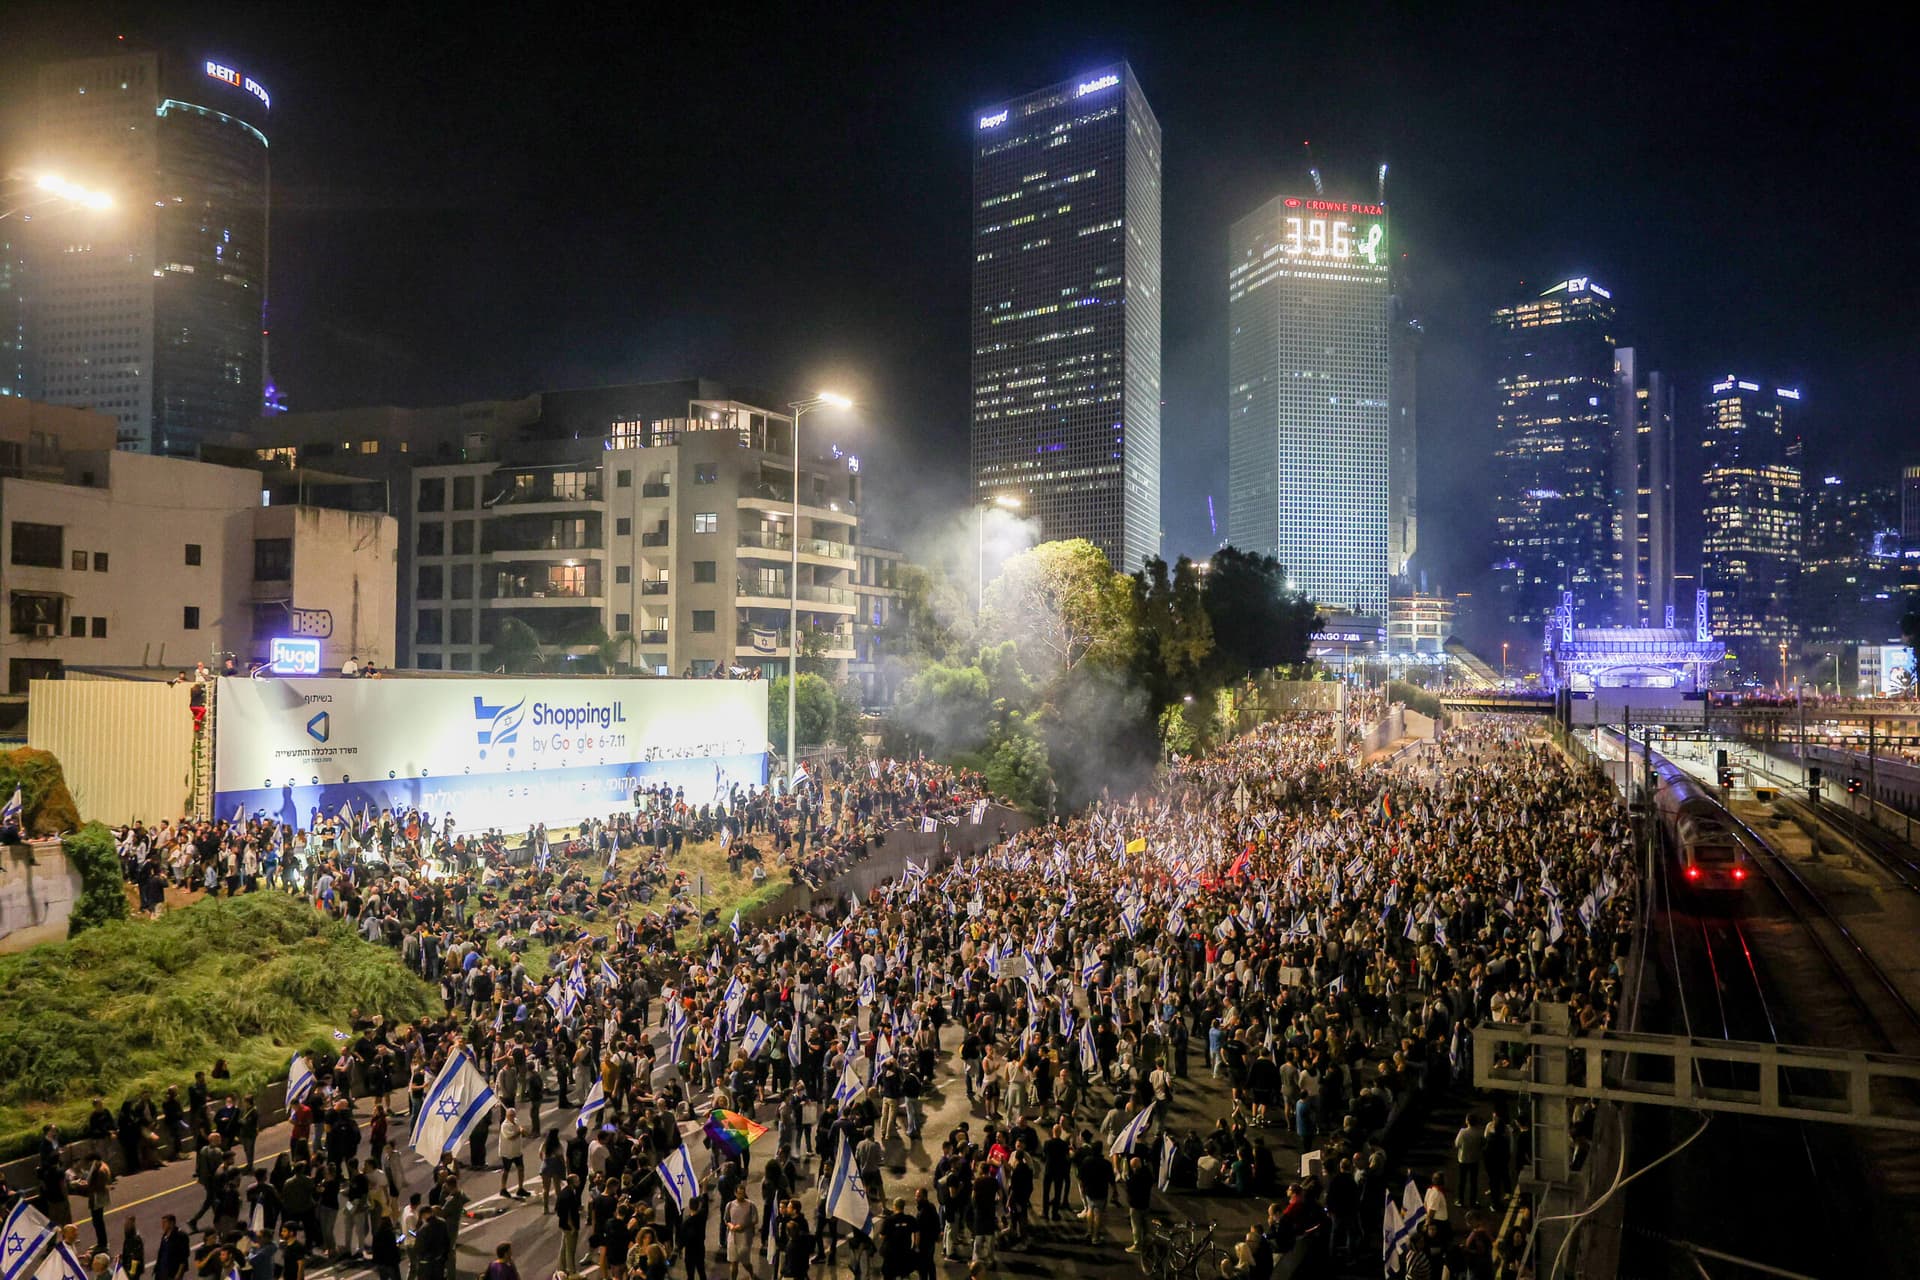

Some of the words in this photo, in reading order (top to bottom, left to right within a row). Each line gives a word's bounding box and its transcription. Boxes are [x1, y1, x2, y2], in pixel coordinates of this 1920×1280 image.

[1307, 200, 1347, 212] CROWNE
[1352, 204, 1382, 214] PLAZA
[1286, 217, 1349, 257] 396
[1568, 277, 1588, 292] EY
[1343, 633, 1360, 641] ZARA
[273, 643, 316, 672] Hugo
[304, 694, 333, 704] בשיתוף
[532, 736, 547, 754] by
[551, 733, 593, 754] Gogle
[599, 734, 625, 749] 6-7.11
[275, 749, 310, 757] והתעשייה
[310, 747, 338, 756] הכלכלה
